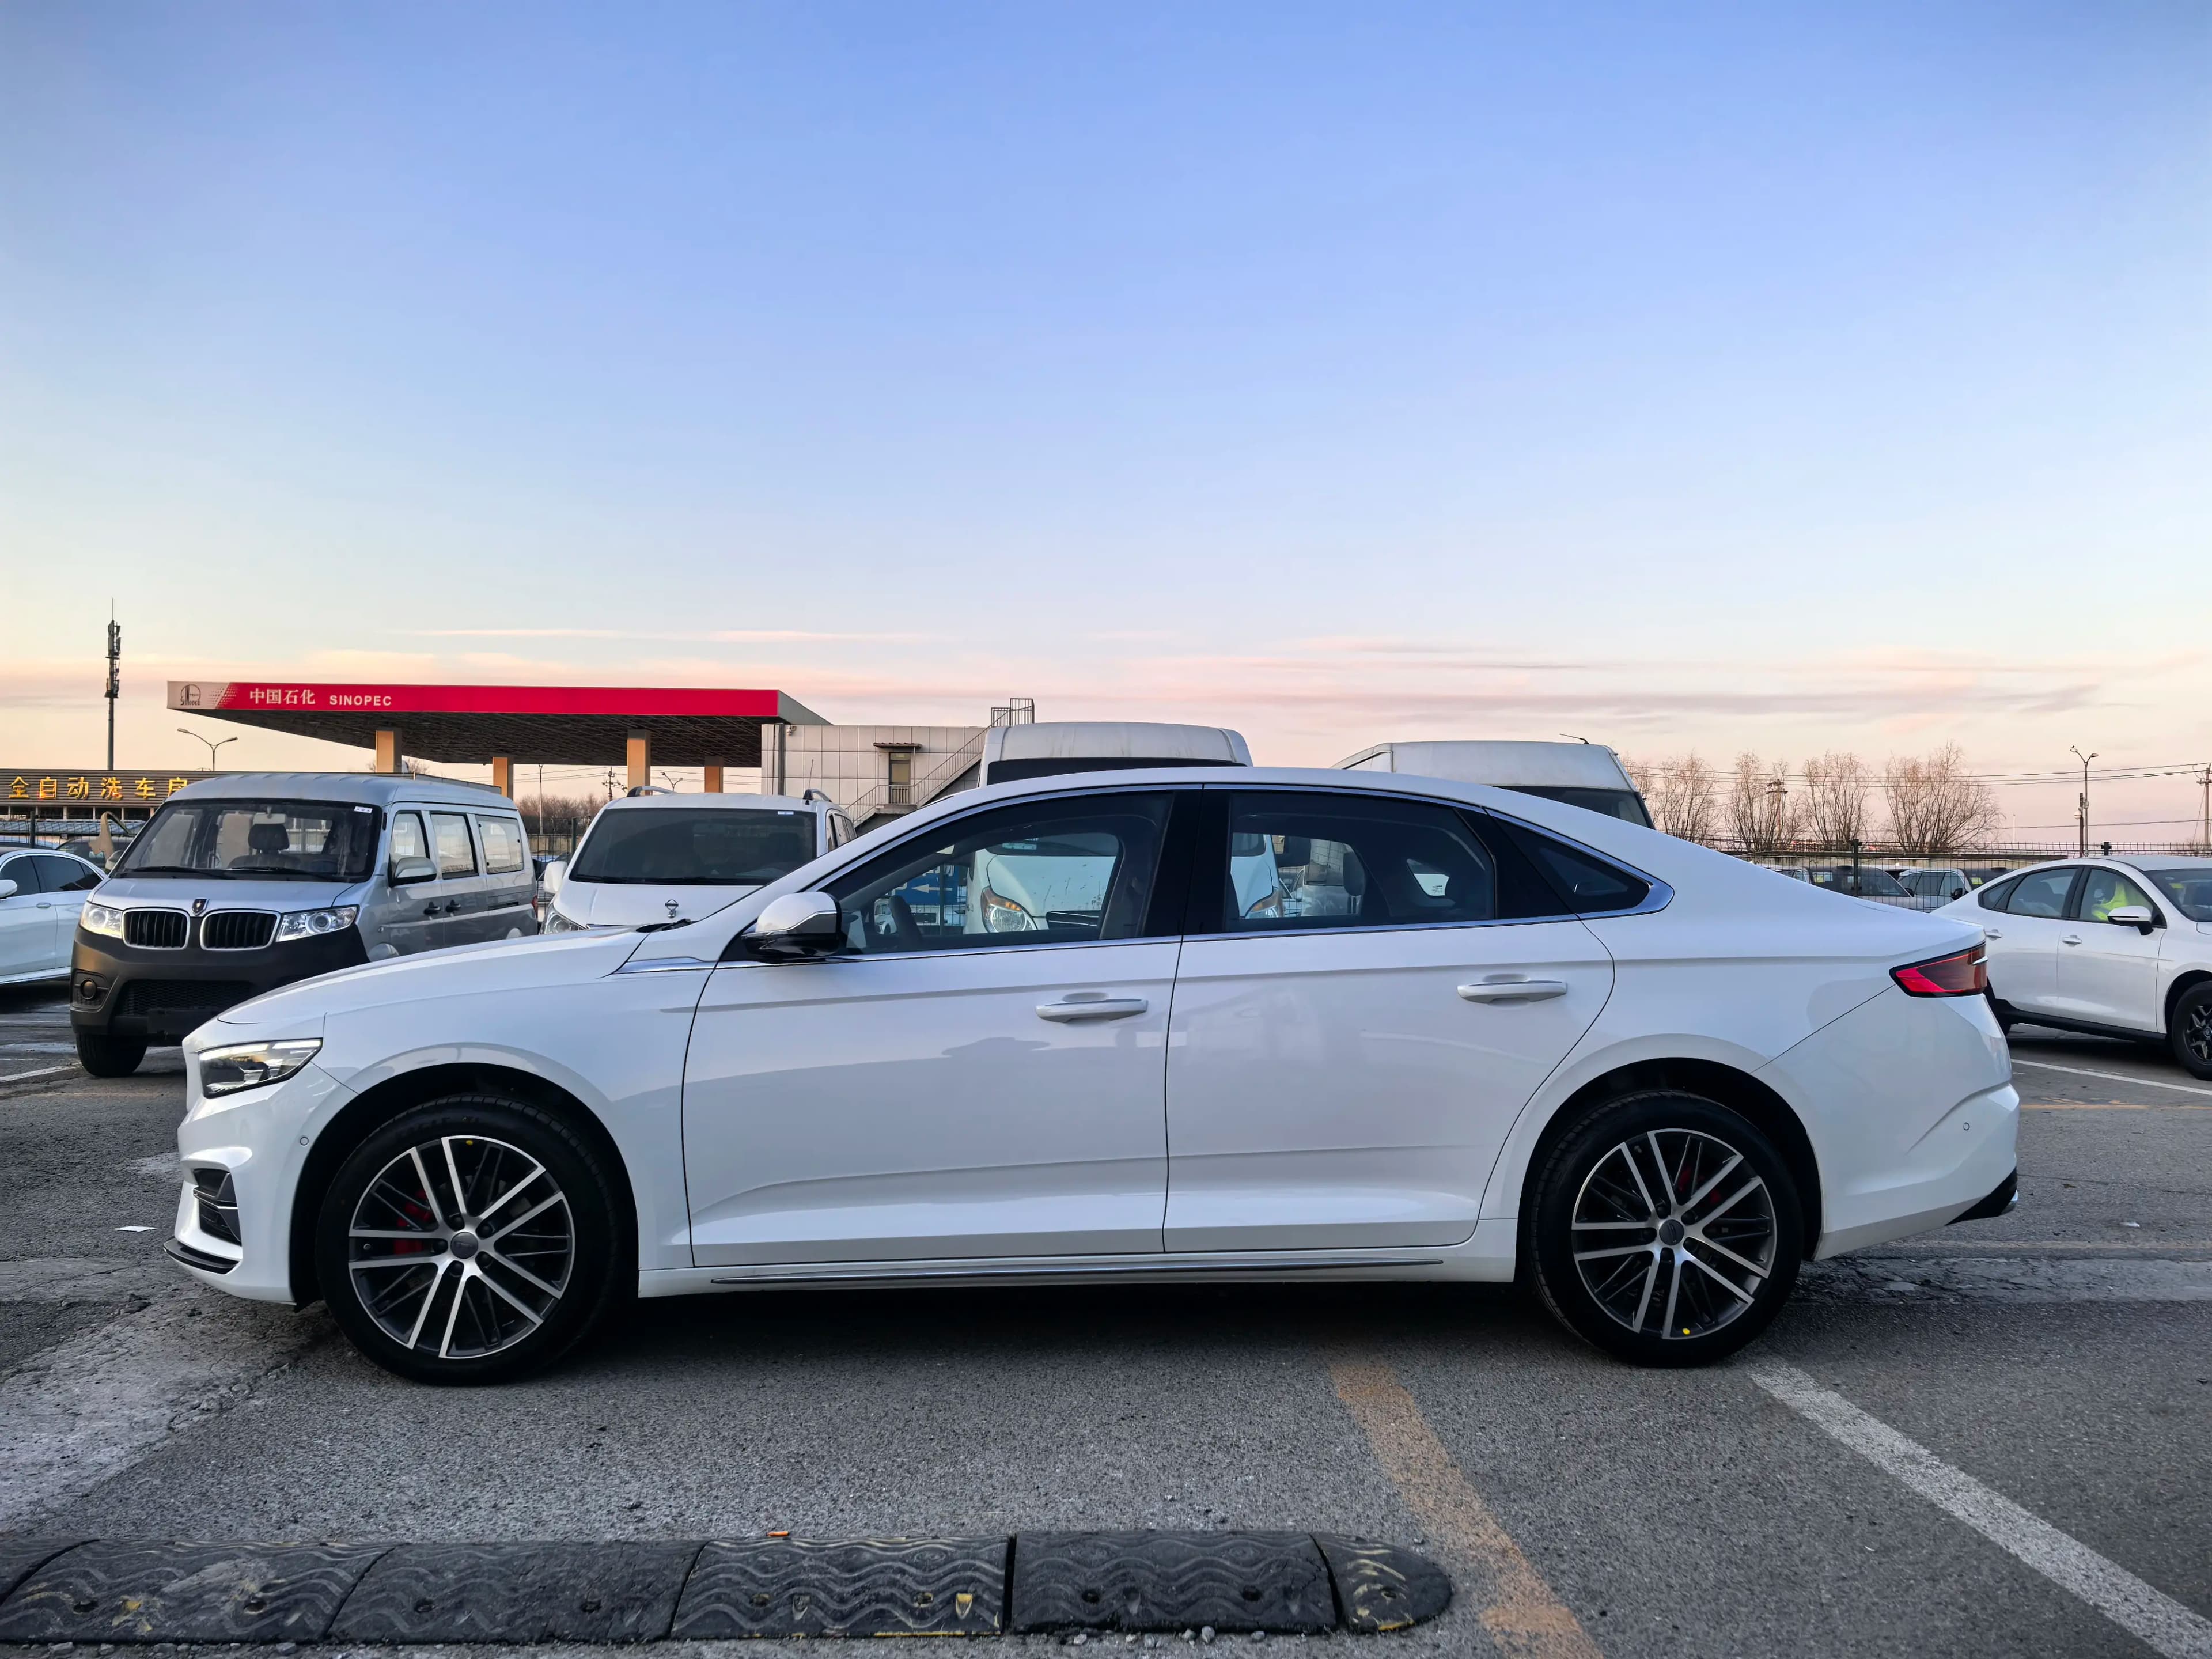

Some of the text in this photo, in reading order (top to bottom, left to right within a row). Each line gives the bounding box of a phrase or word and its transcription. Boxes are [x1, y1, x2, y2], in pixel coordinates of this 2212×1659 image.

[249, 688, 316, 705] 中国石化
[329, 695, 392, 706] SINOPEC
